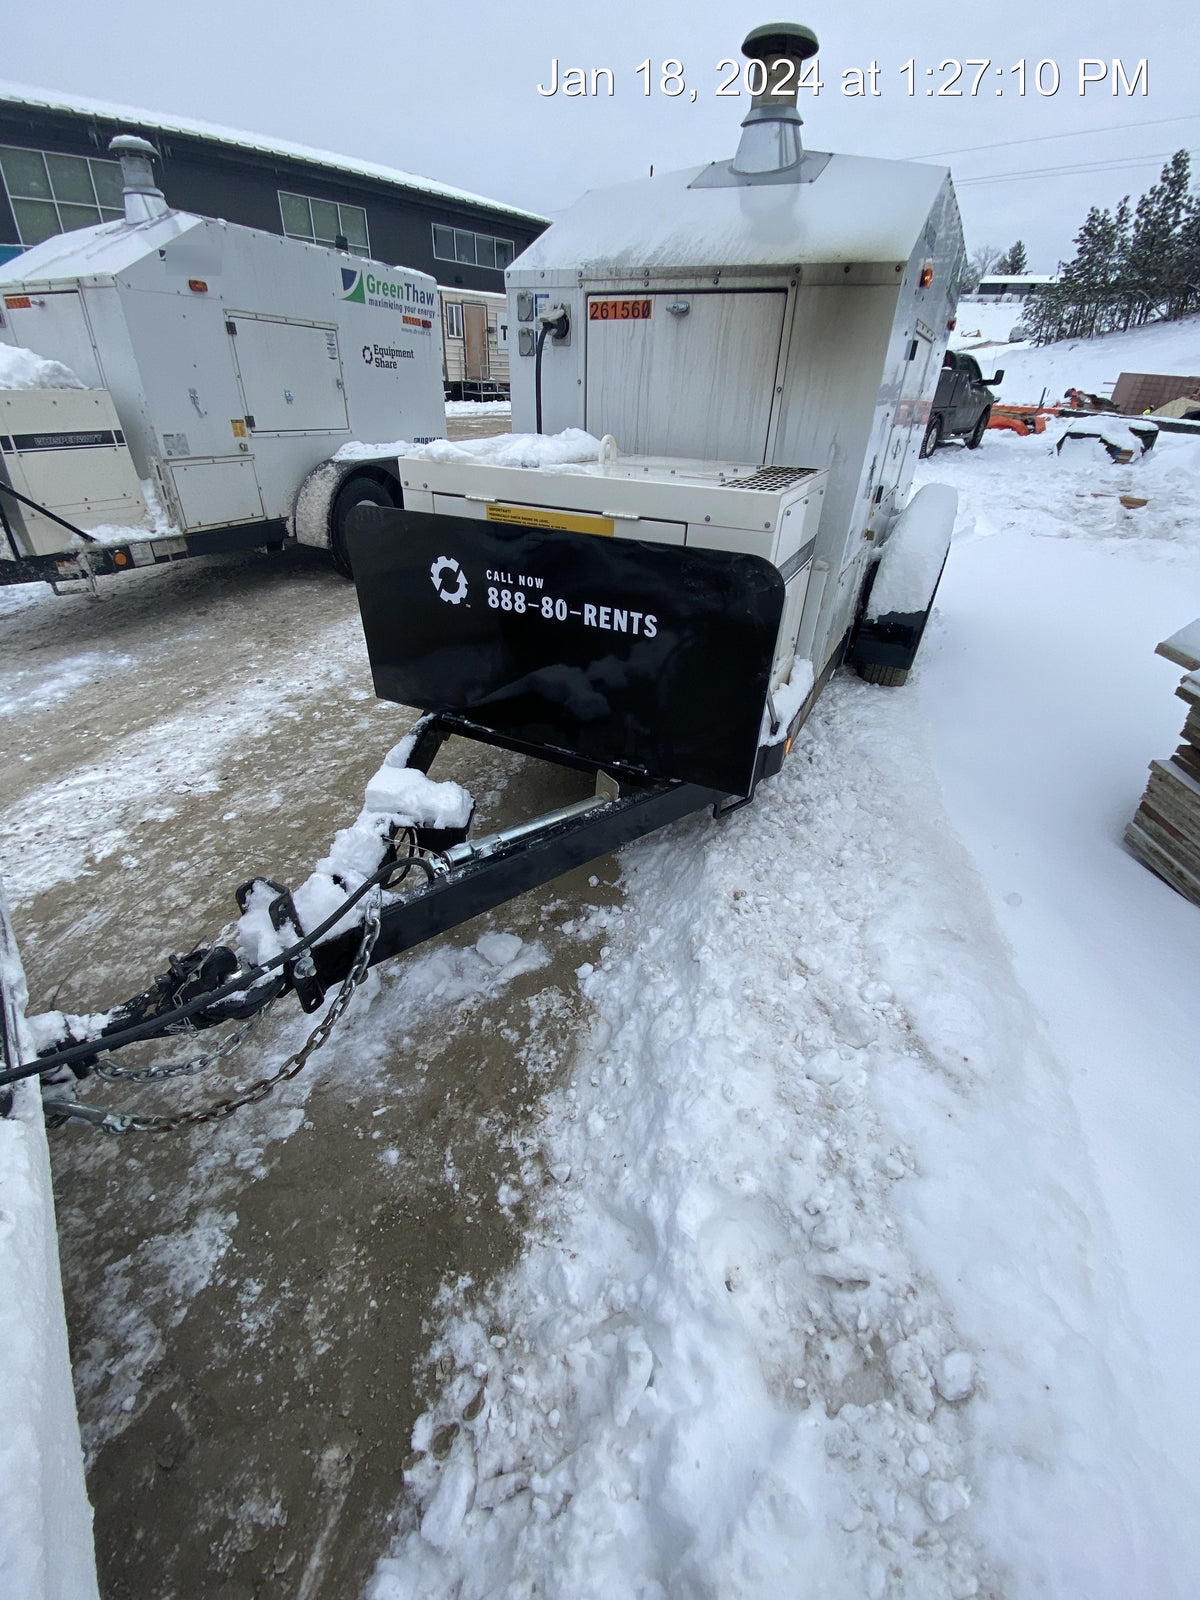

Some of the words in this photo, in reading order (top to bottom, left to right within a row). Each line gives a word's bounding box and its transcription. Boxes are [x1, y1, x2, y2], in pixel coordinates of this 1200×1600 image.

[366, 273, 435, 306] GreenThaw
[368, 298, 403, 313] maximizing
[404, 304, 417, 314] your
[417, 308, 435, 319] energy
[590, 300, 651, 319] 261560
[373, 344, 414, 359] Equipment
[375, 357, 397, 369] Share
[486, 569, 513, 585] CALL
[519, 575, 544, 589] NOW
[487, 586, 658, 638] 888-80-RENTS
